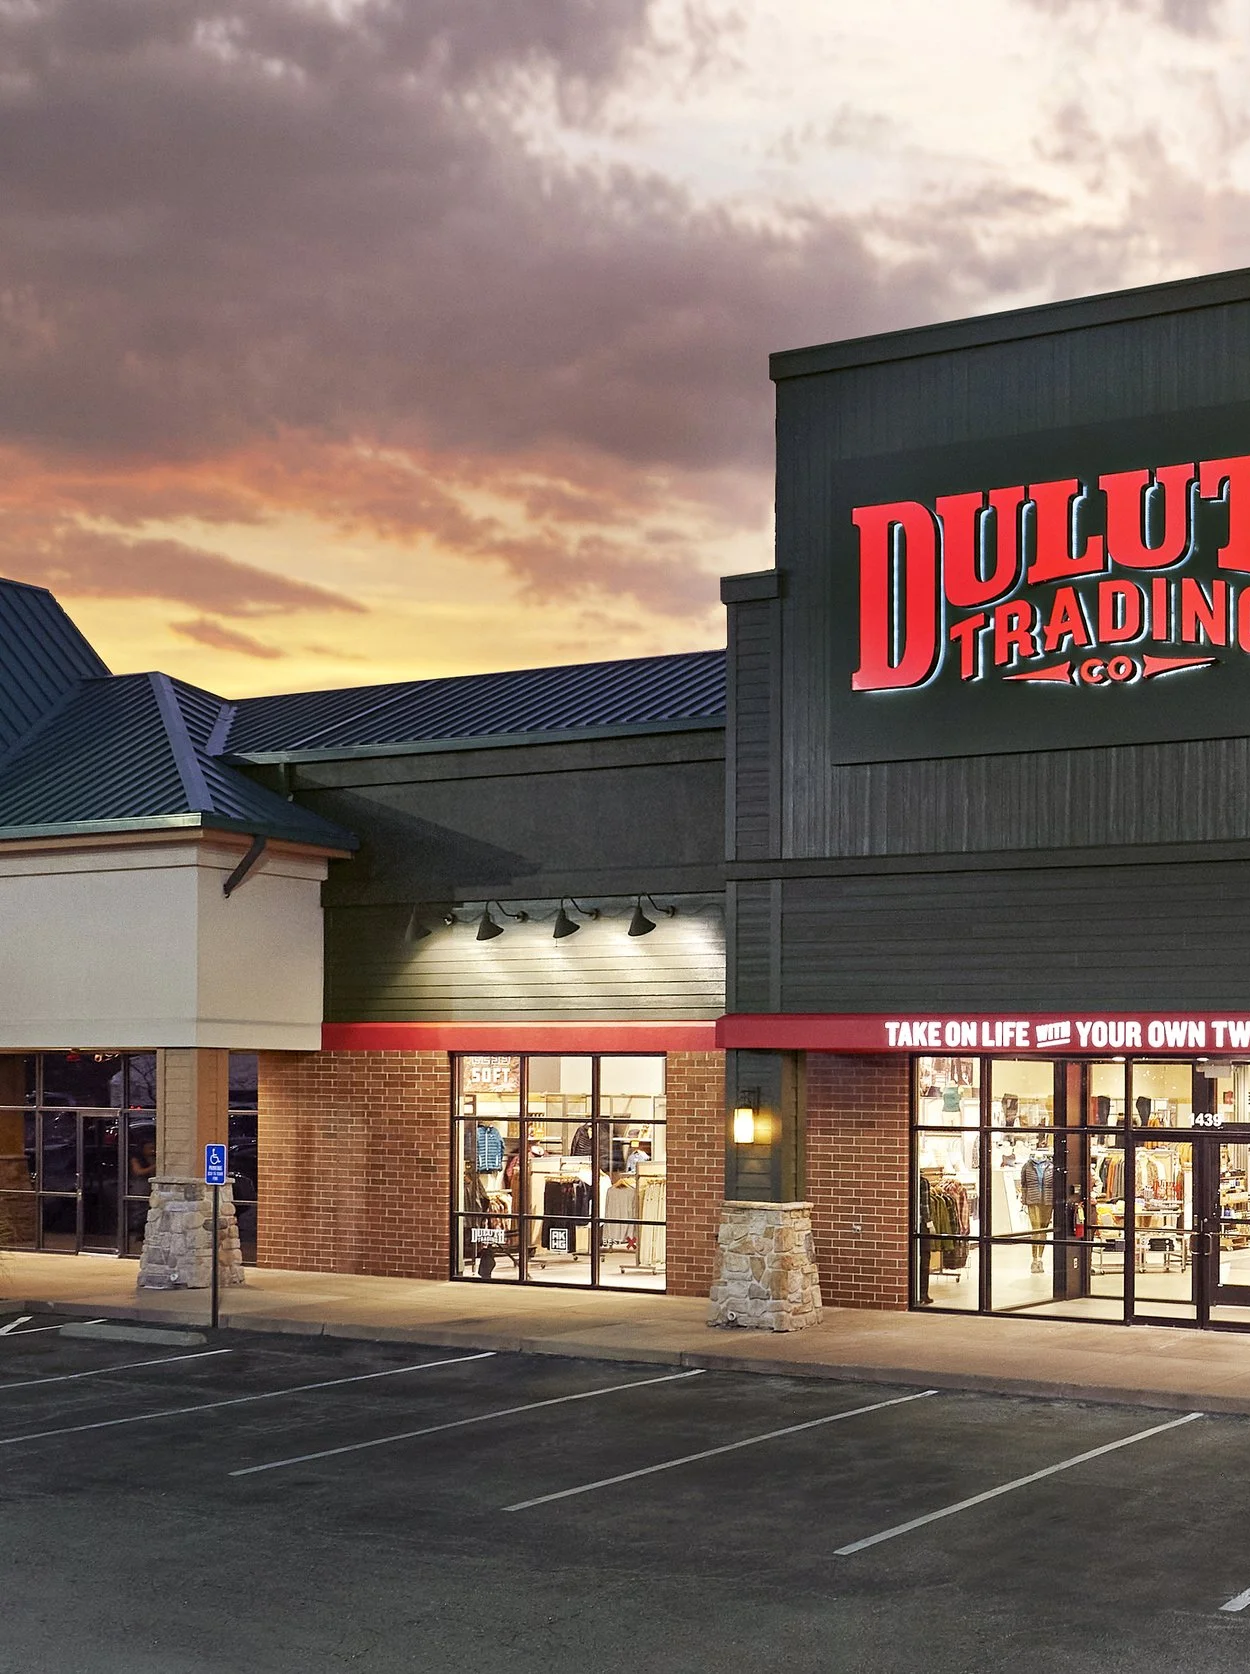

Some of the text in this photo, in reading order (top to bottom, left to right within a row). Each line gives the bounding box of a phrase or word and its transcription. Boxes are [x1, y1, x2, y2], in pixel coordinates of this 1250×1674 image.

[1081, 655, 1131, 684] CO
[885, 1021, 941, 1047] TAKE
[945, 1021, 977, 1047] ON
[982, 1021, 1030, 1047] LIFE
[1035, 1020, 1071, 1043] WITH
[1075, 1021, 1142, 1047] YOUR
[1148, 1020, 1206, 1048] OWN
[471, 1067, 511, 1083] SOFT
[1188, 1112, 1222, 1127] 1439
